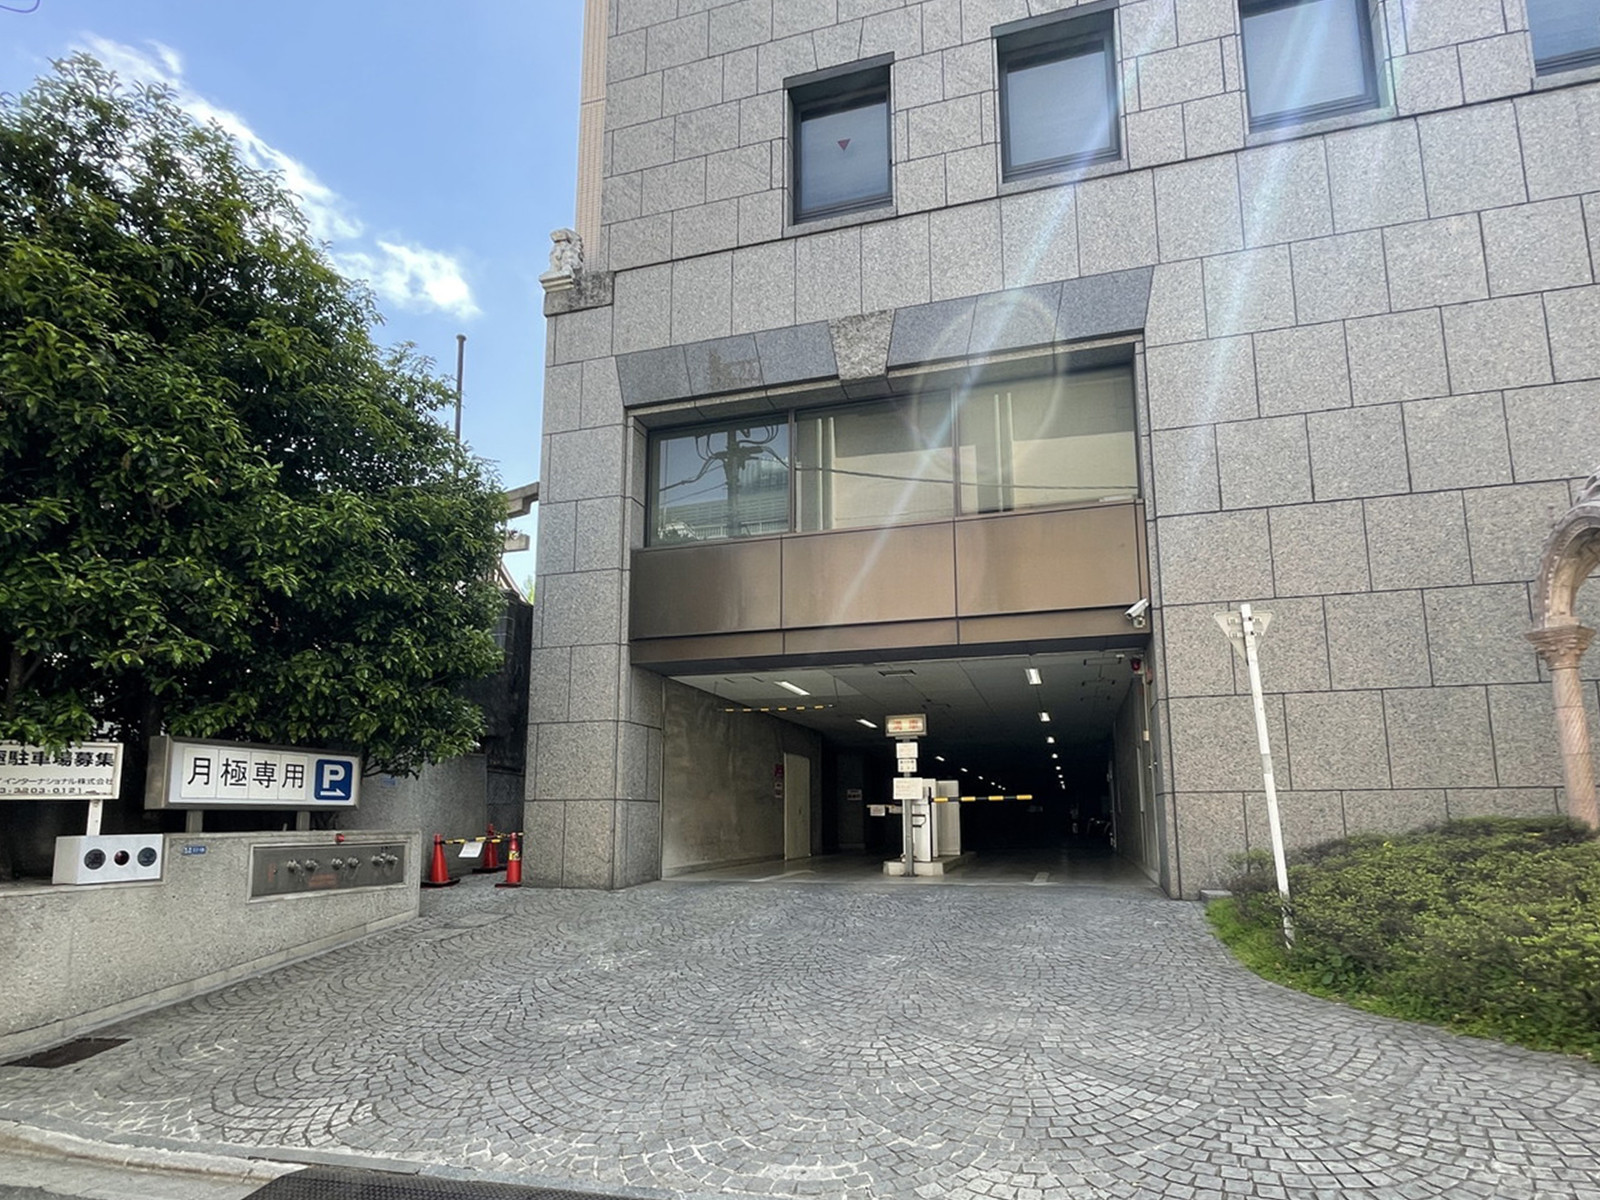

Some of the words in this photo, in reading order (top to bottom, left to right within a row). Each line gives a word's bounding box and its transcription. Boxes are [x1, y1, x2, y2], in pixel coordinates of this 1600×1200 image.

[187, 757, 305, 789] 月極専用
[323, 764, 345, 789] P
